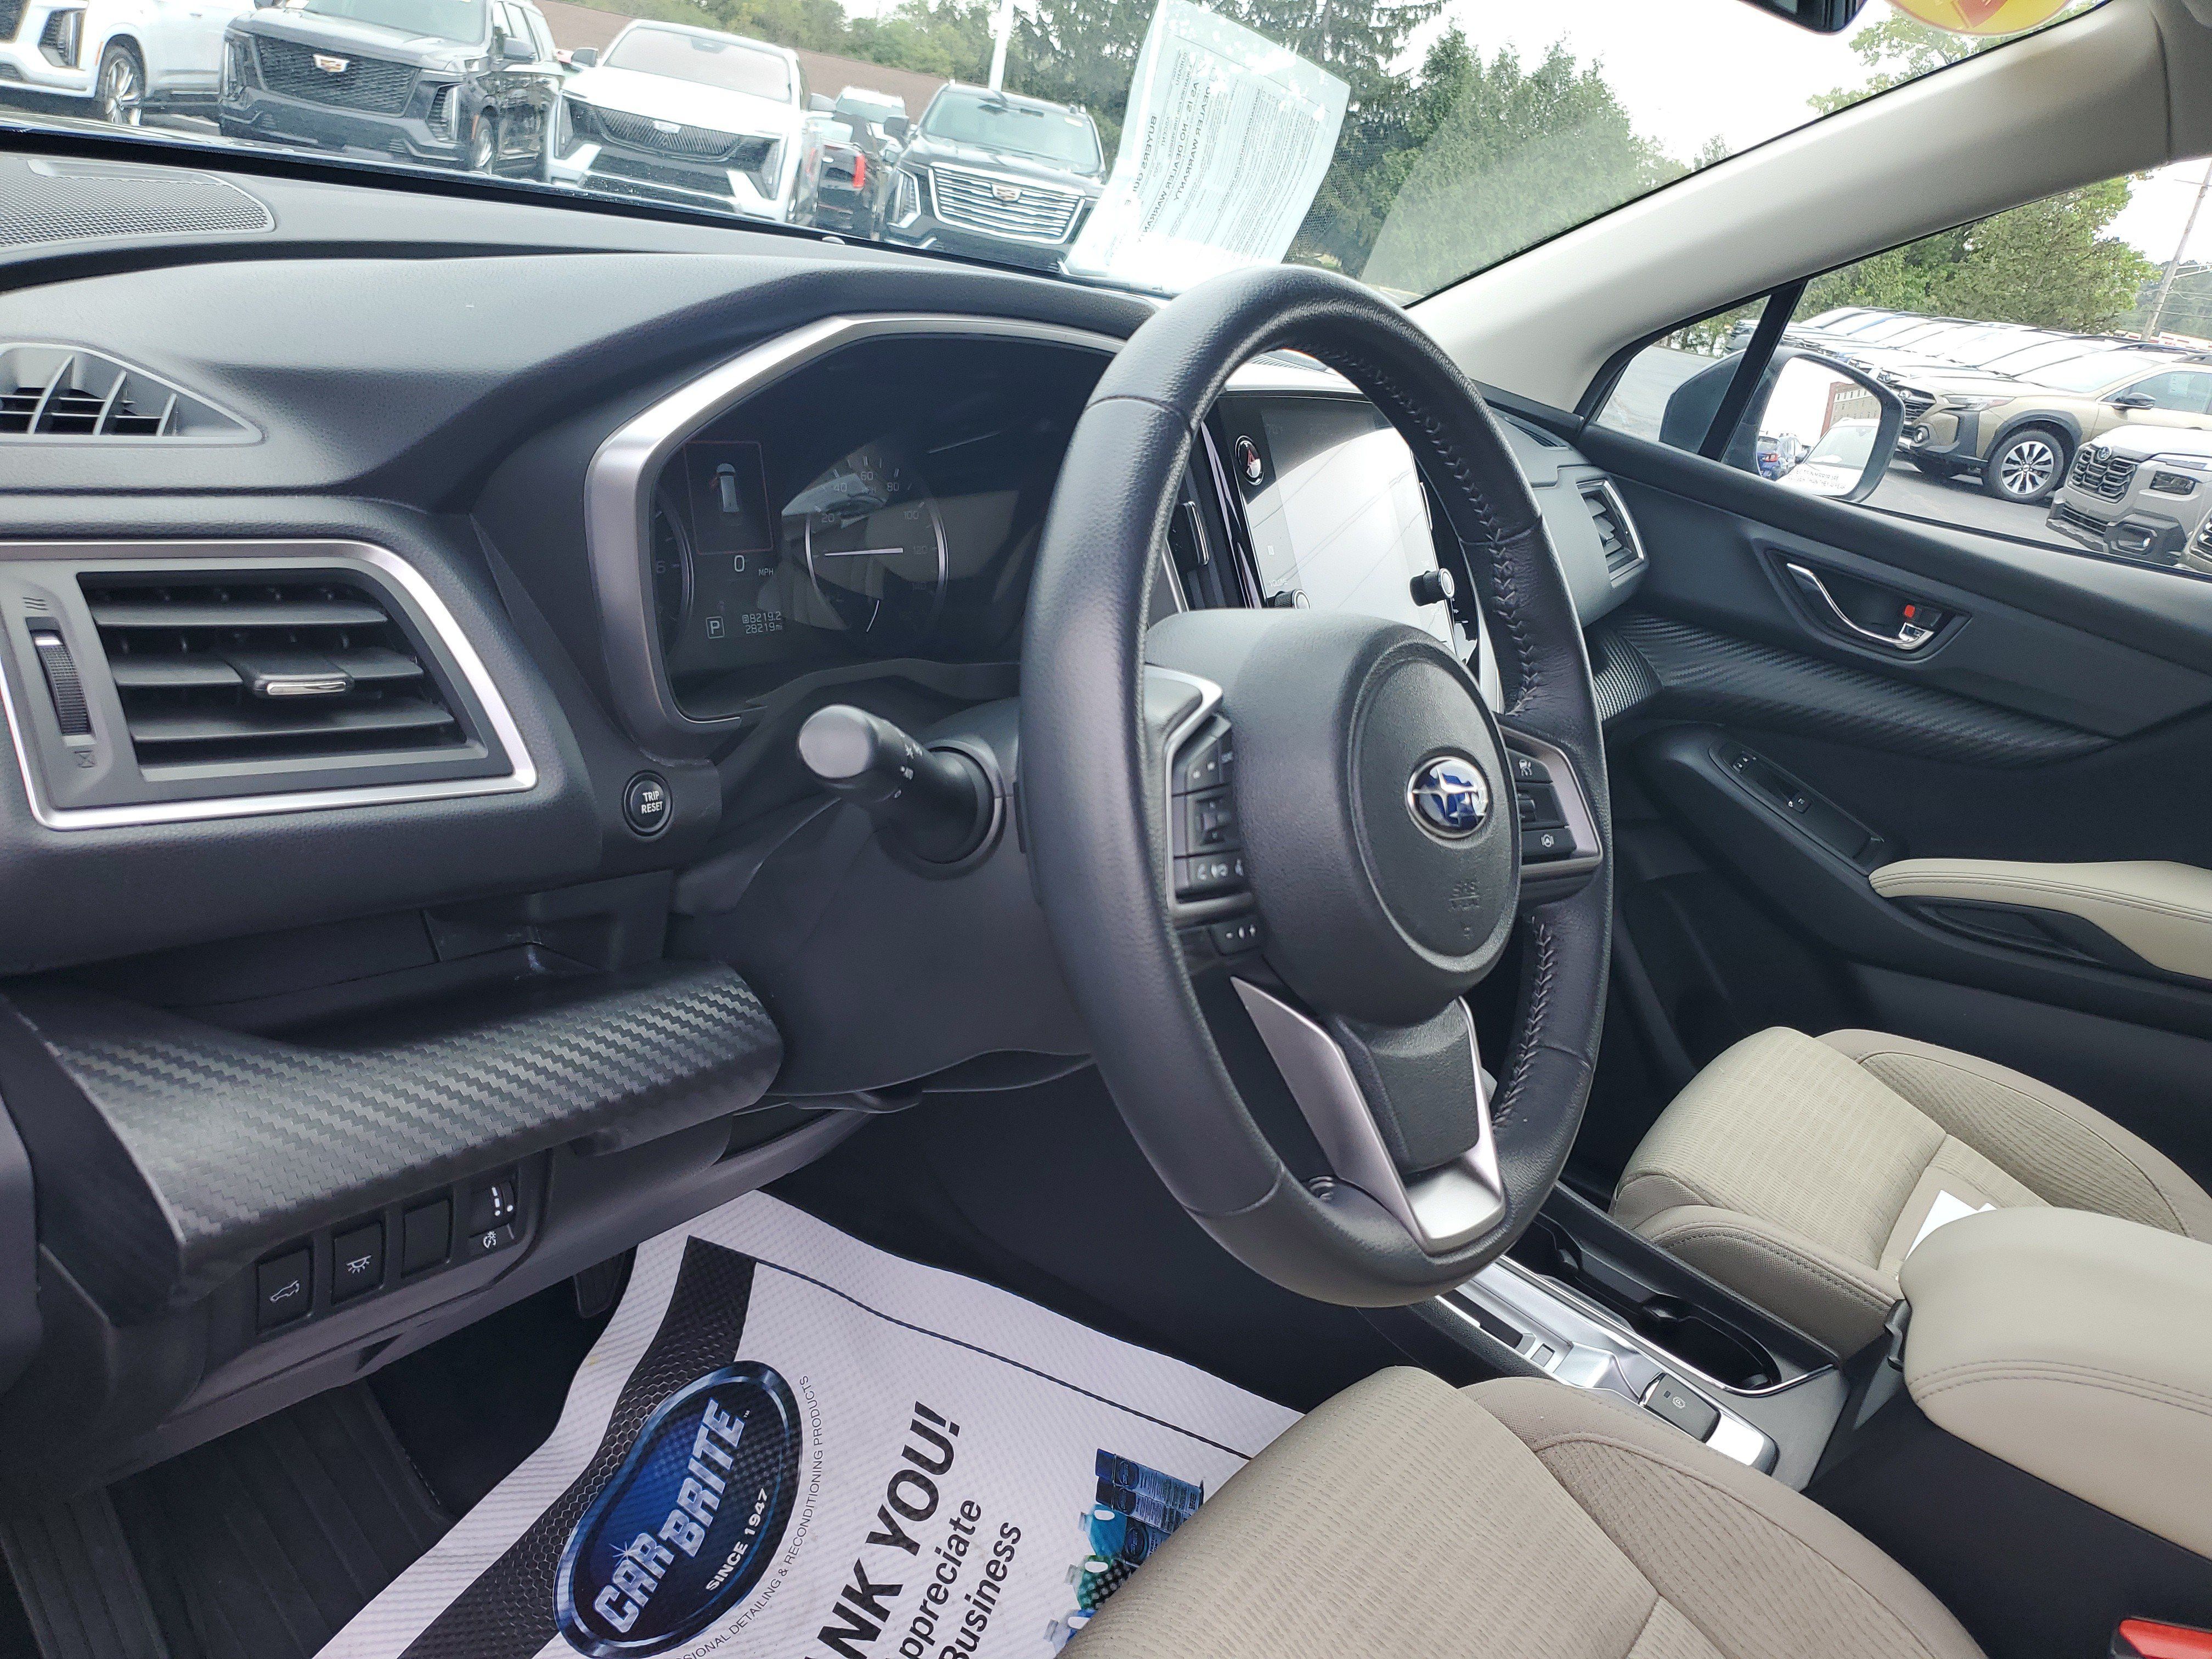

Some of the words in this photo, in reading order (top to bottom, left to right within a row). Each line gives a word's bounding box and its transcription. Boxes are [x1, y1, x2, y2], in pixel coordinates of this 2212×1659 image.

[861, 471, 873, 481] 60
[834, 483, 847, 492] 40
[887, 482, 899, 491] 80
[822, 513, 834, 523] 20
[734, 555, 745, 572] 0
[758, 568, 774, 577] MPH
[642, 791, 659, 803] TRIP
[641, 801, 663, 814] RESET
[799, 1375, 823, 1446] PRODUCTS
[594, 1532, 675, 1634] CAR
[658, 1397, 746, 1559] BRITE
[783, 1449, 823, 1565] RECONDITIONING
[804, 1557, 904, 1659] NK
[865, 1400, 961, 1556] YOU!
[705, 1541, 748, 1591] SINCE
[744, 1488, 768, 1536] 1947
[778, 1568, 789, 1577] &
[885, 1500, 981, 1659] ppreciate
[729, 1578, 782, 1635] DETAILING
[676, 1634, 731, 1659] SIONAL
